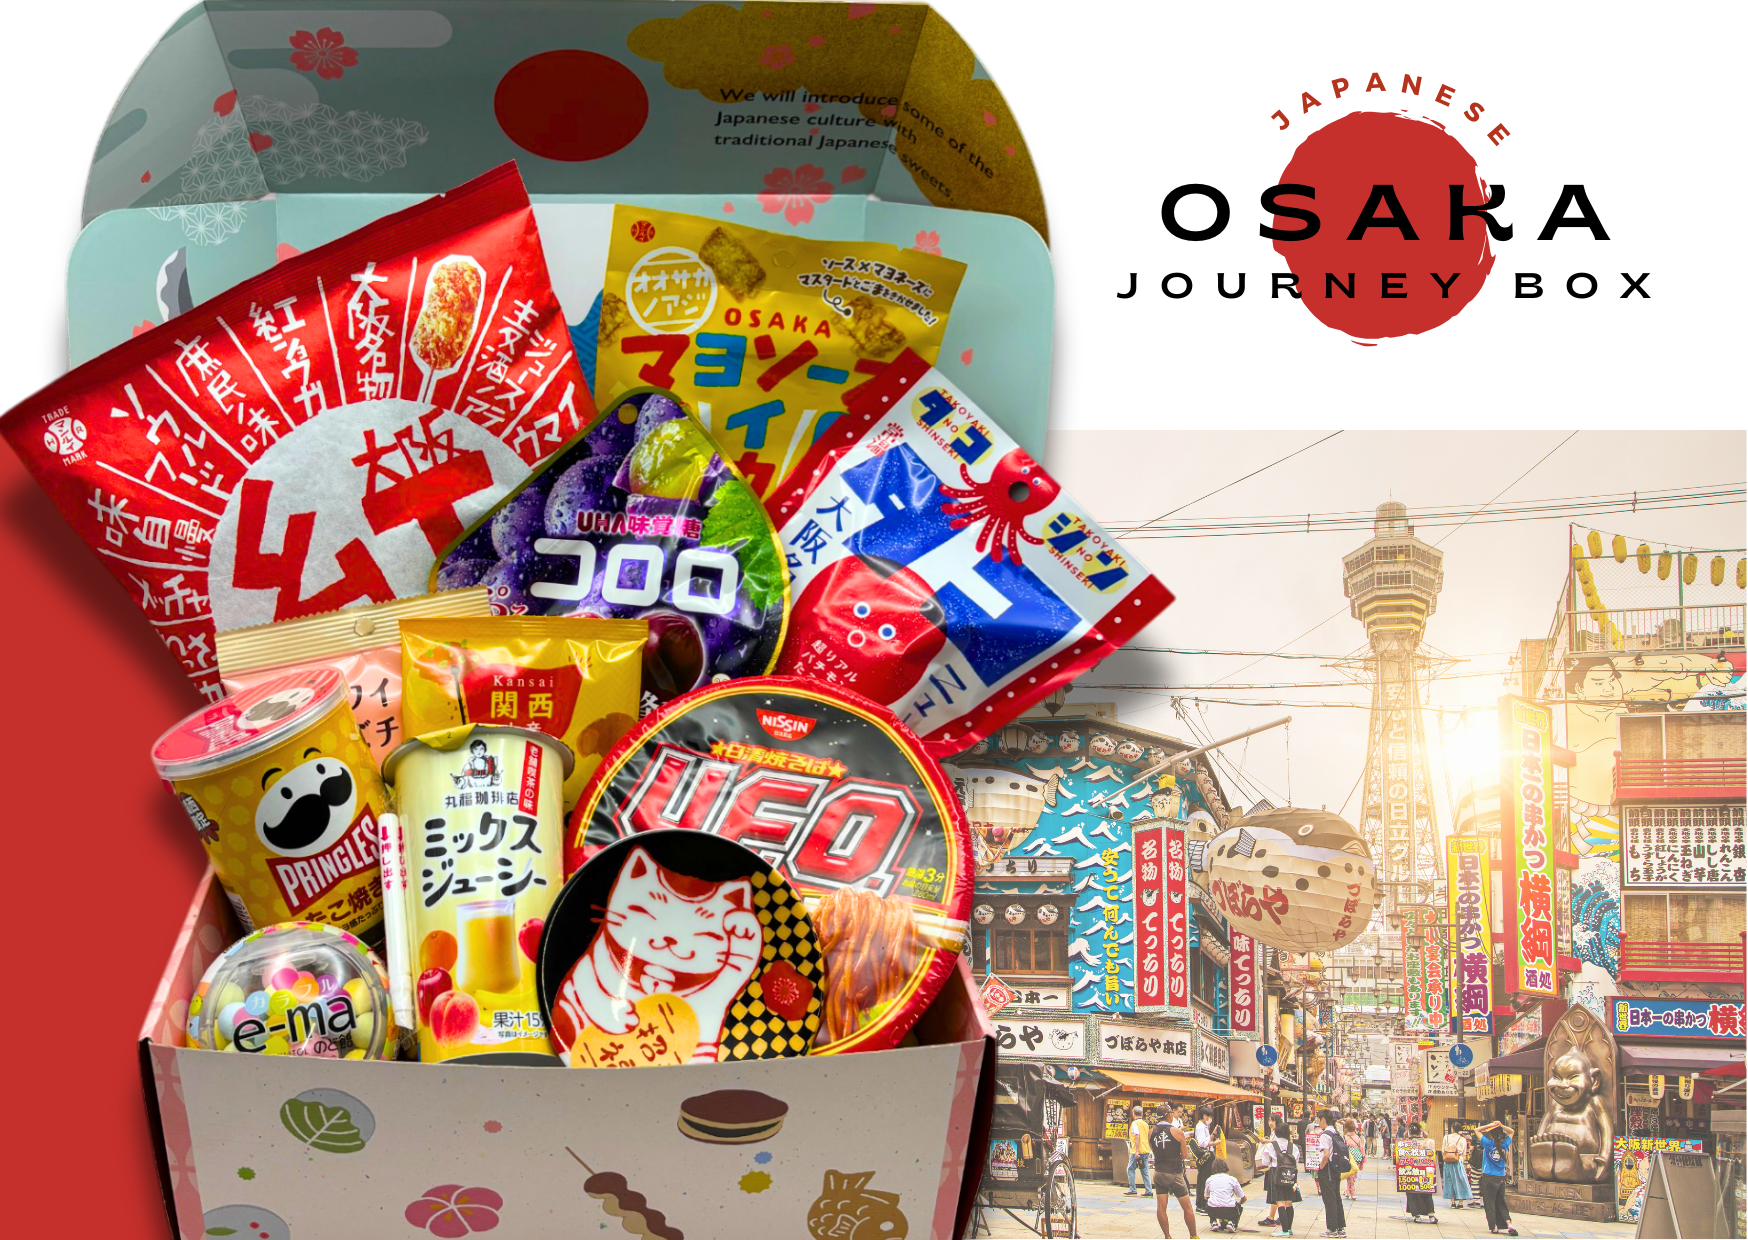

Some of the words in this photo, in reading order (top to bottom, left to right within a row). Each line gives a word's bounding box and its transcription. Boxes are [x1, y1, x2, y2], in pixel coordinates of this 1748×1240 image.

[715, 111, 800, 126] Japanese
[807, 114, 876, 127] culture
[883, 117, 917, 144] with
[720, 88, 755, 102] We
[762, 90, 796, 103] will
[802, 91, 899, 106] introduce
[903, 102, 944, 138] some
[949, 137, 967, 156] of
[968, 153, 994, 179] the
[714, 134, 813, 147] traditional
[819, 134, 897, 154] Japanese
[901, 152, 954, 201] sweets.
[632, 268, 713, 293] オオサカ
[642, 295, 706, 317] ノアジ
[348, 262, 395, 400] 大阪名物
[724, 308, 831, 338] OSAKA
[42, 406, 70, 423] TRADE
[919, 389, 993, 465] タコ
[940, 389, 991, 436] TAKOYAKI
[943, 418, 959, 433] NO
[351, 406, 462, 493] 大阪
[916, 419, 959, 460] SHINSEKI
[63, 450, 88, 466] MARK
[577, 512, 702, 540] UHA味覚糖
[1073, 516, 1126, 567] TAKOYAKI
[1048, 546, 1094, 589] SHINSEKI
[1076, 546, 1093, 562] NO
[531, 538, 739, 614] コロロ
[494, 675, 554, 687] Kansai
[491, 691, 553, 719] 関西
[1515, 703, 1548, 731] 新世界
[762, 714, 808, 733] NISSIN
[725, 743, 830, 776] 日清焼そば
[445, 791, 518, 808] 丸福珈琲店
[1521, 728, 1549, 869] 日本一の串かつ
[424, 812, 542, 857] ミックス
[275, 813, 381, 907] PRINGLES
[1142, 840, 1158, 881] 名物
[1169, 839, 1184, 881] 名物
[422, 858, 547, 908] ジューシー
[1212, 878, 1289, 925] づぼらや
[1333, 883, 1362, 941] づぼらや
[1519, 871, 1554, 967] 横綱
[1523, 968, 1552, 991] 酒処
[233, 996, 356, 1053] e-ma
[1619, 1003, 1629, 1030] 新世界
[1630, 1012, 1706, 1028] 日本一の串かつ
[314, 1034, 353, 1053] のど飴
[1105, 1035, 1187, 1056] づぼらや本店
[1616, 1137, 1681, 1152] 大阪新世界
[1525, 1183, 1582, 1199] BILLIKEN
